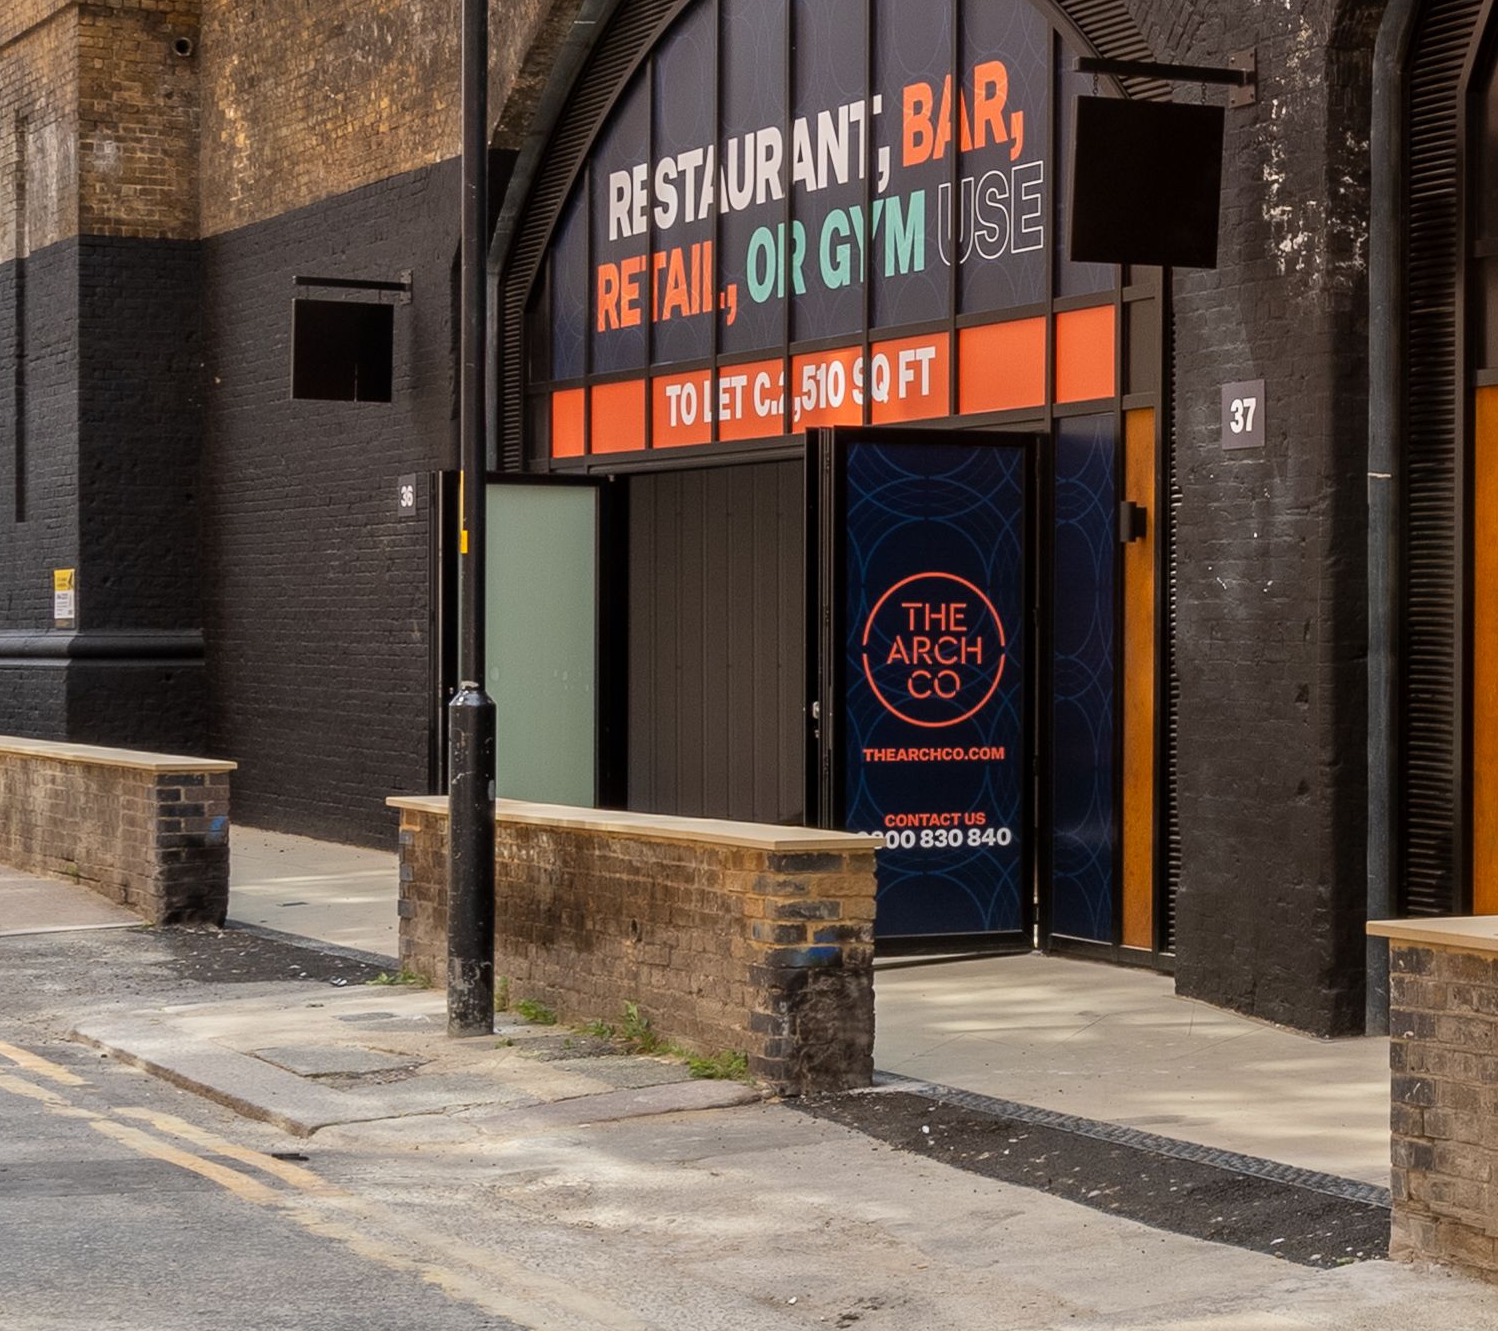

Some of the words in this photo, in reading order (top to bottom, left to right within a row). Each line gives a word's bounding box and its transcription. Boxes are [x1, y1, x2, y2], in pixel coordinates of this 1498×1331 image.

[609, 93, 891, 241] RESTAURANT,
[902, 60, 1024, 167] BAR,
[597, 240, 738, 333] RETAIL,
[746, 220, 807, 303] OR
[819, 190, 925, 290] GYM
[938, 160, 1044, 266] USE
[666, 382, 697, 427] TO
[703, 374, 748, 424] LET
[852, 352, 890, 404] SQ
[898, 346, 936, 399] FT
[1230, 397, 1257, 433] 37
[400, 485, 414, 507] 36
[901, 603, 968, 631] THE
[887, 635, 983, 665] ARCH
[908, 670, 961, 699] CO
[863, 746, 1006, 763] THEARCHCO.COM
[884, 813, 961, 828] CONTACT
[964, 811, 986, 826] US
[857, 829, 916, 850] 00
[919, 828, 964, 849] 830
[966, 827, 1012, 847] 840
